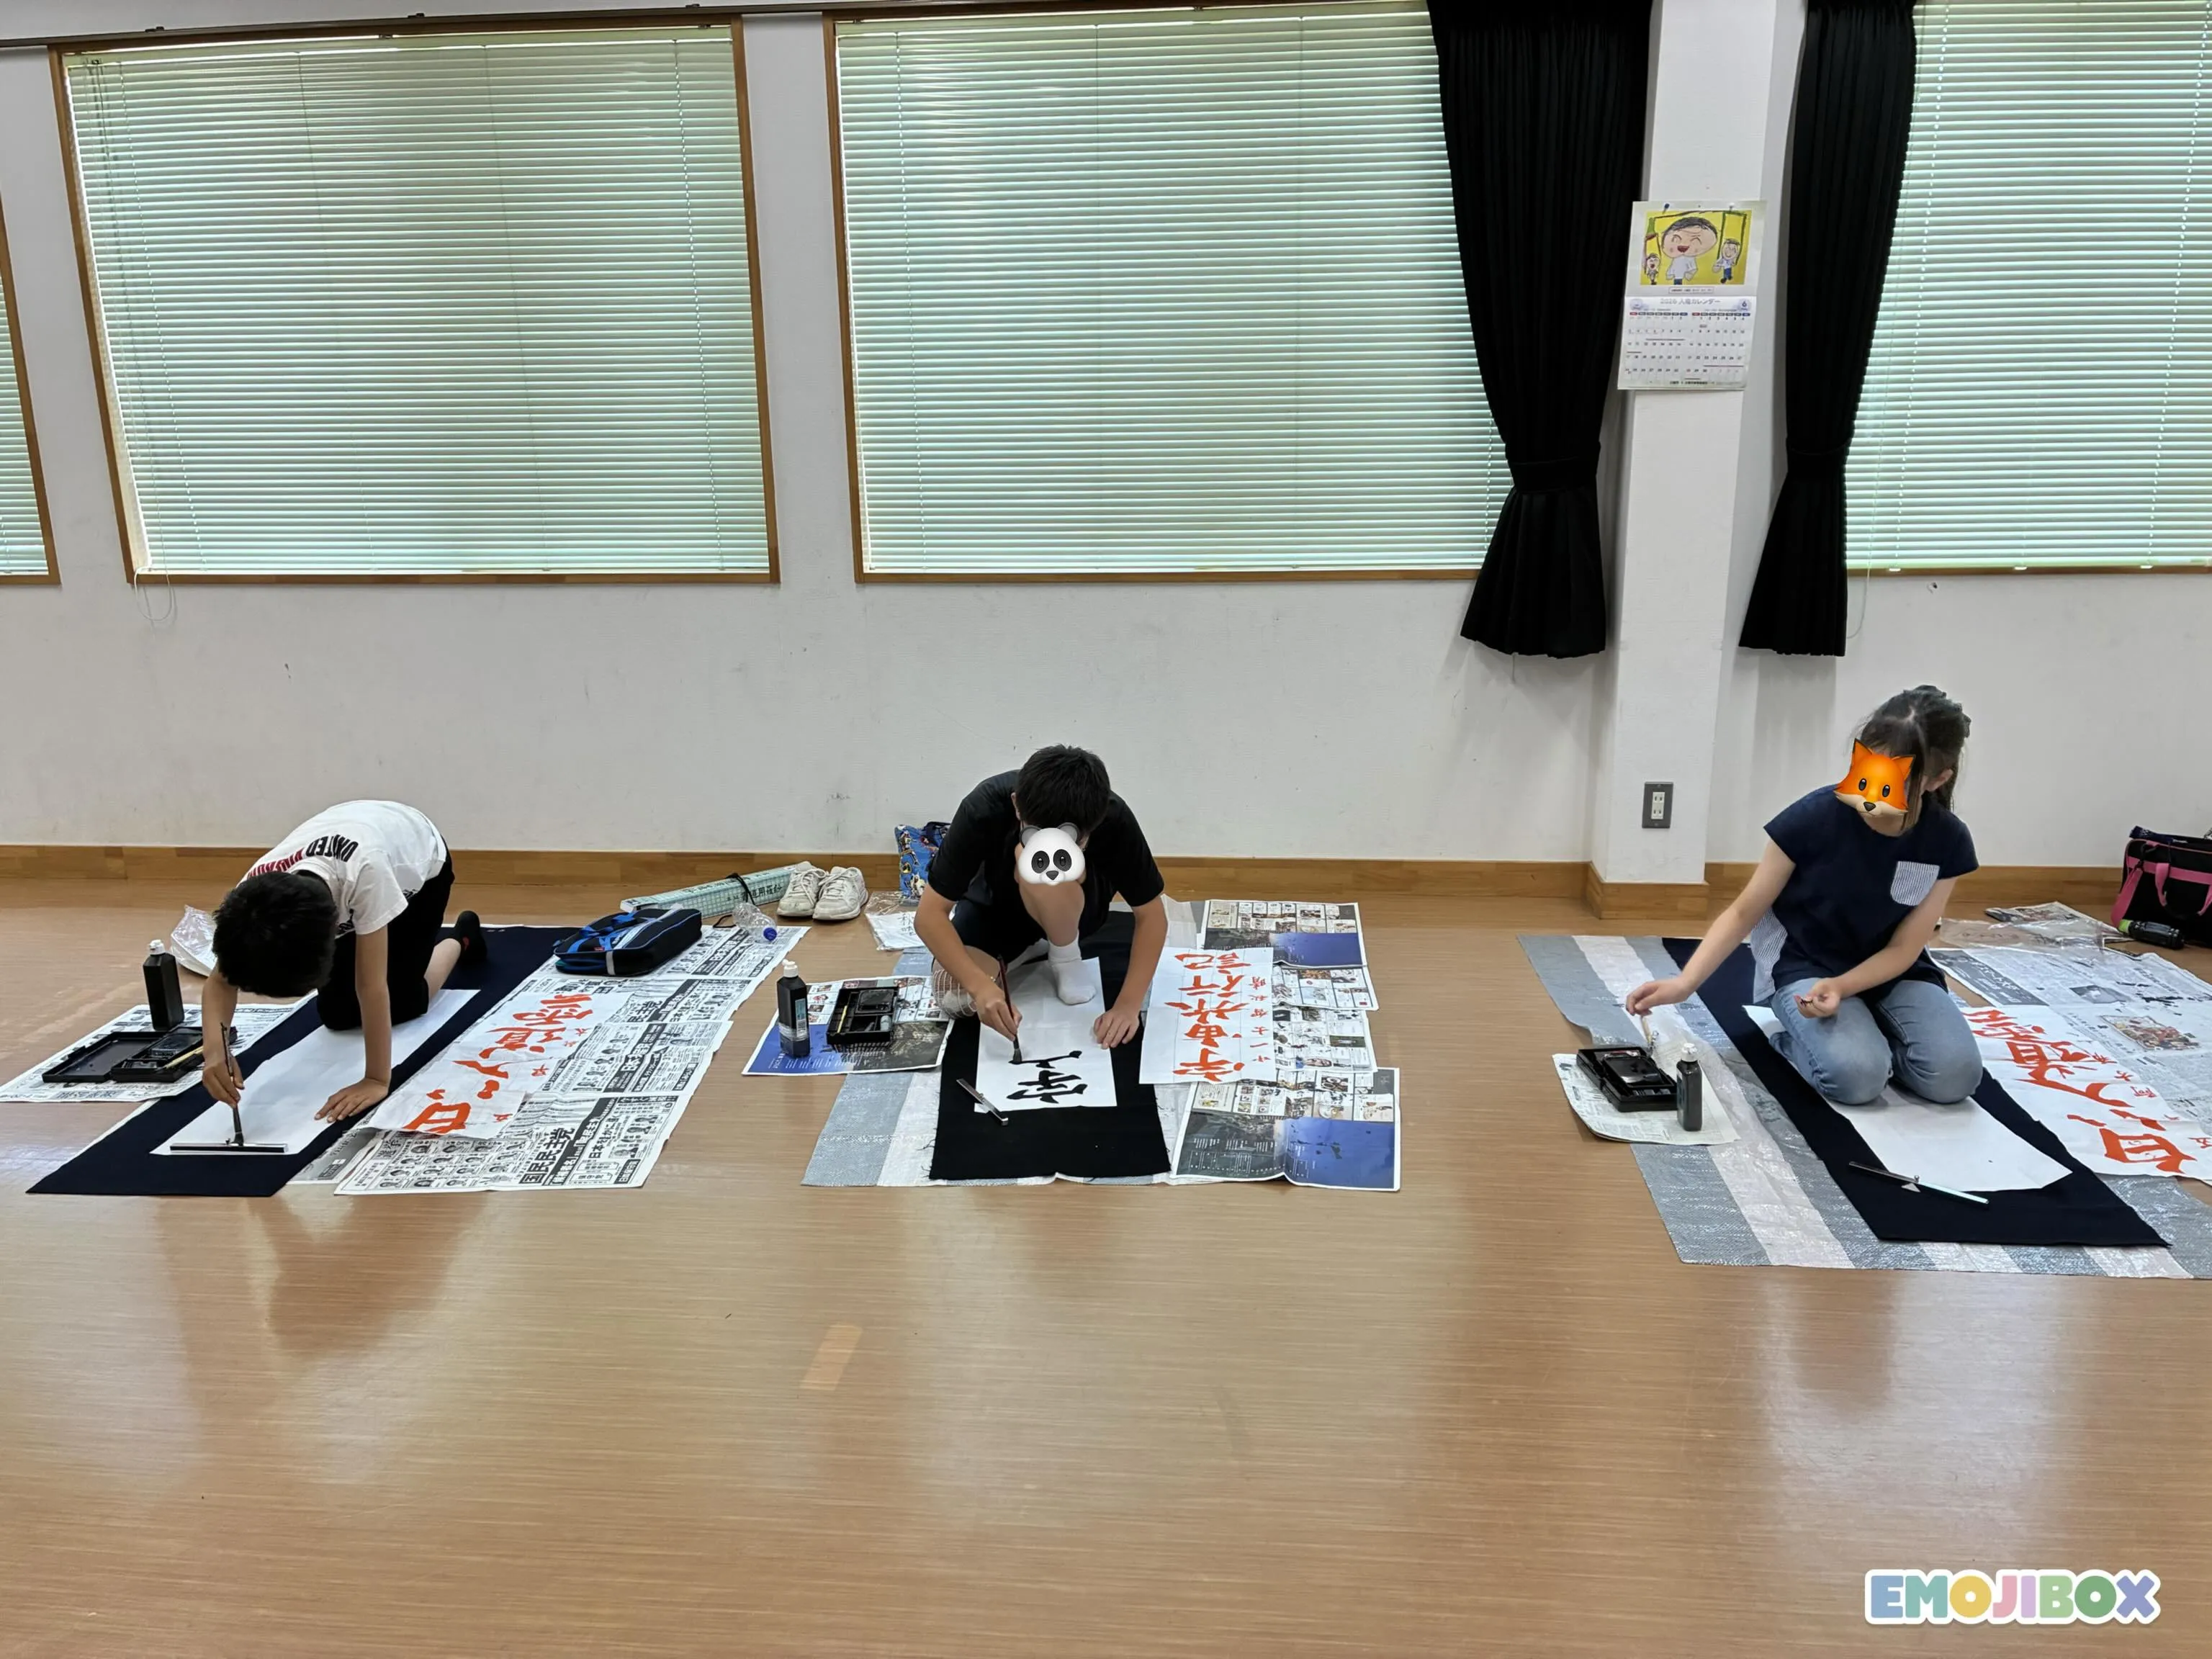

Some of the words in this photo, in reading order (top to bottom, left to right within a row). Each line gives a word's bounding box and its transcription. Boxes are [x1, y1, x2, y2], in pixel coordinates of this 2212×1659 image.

[1164, 953, 1251, 1082] 宇宙旅行記
[518, 1127, 577, 1184] 国民民主党
